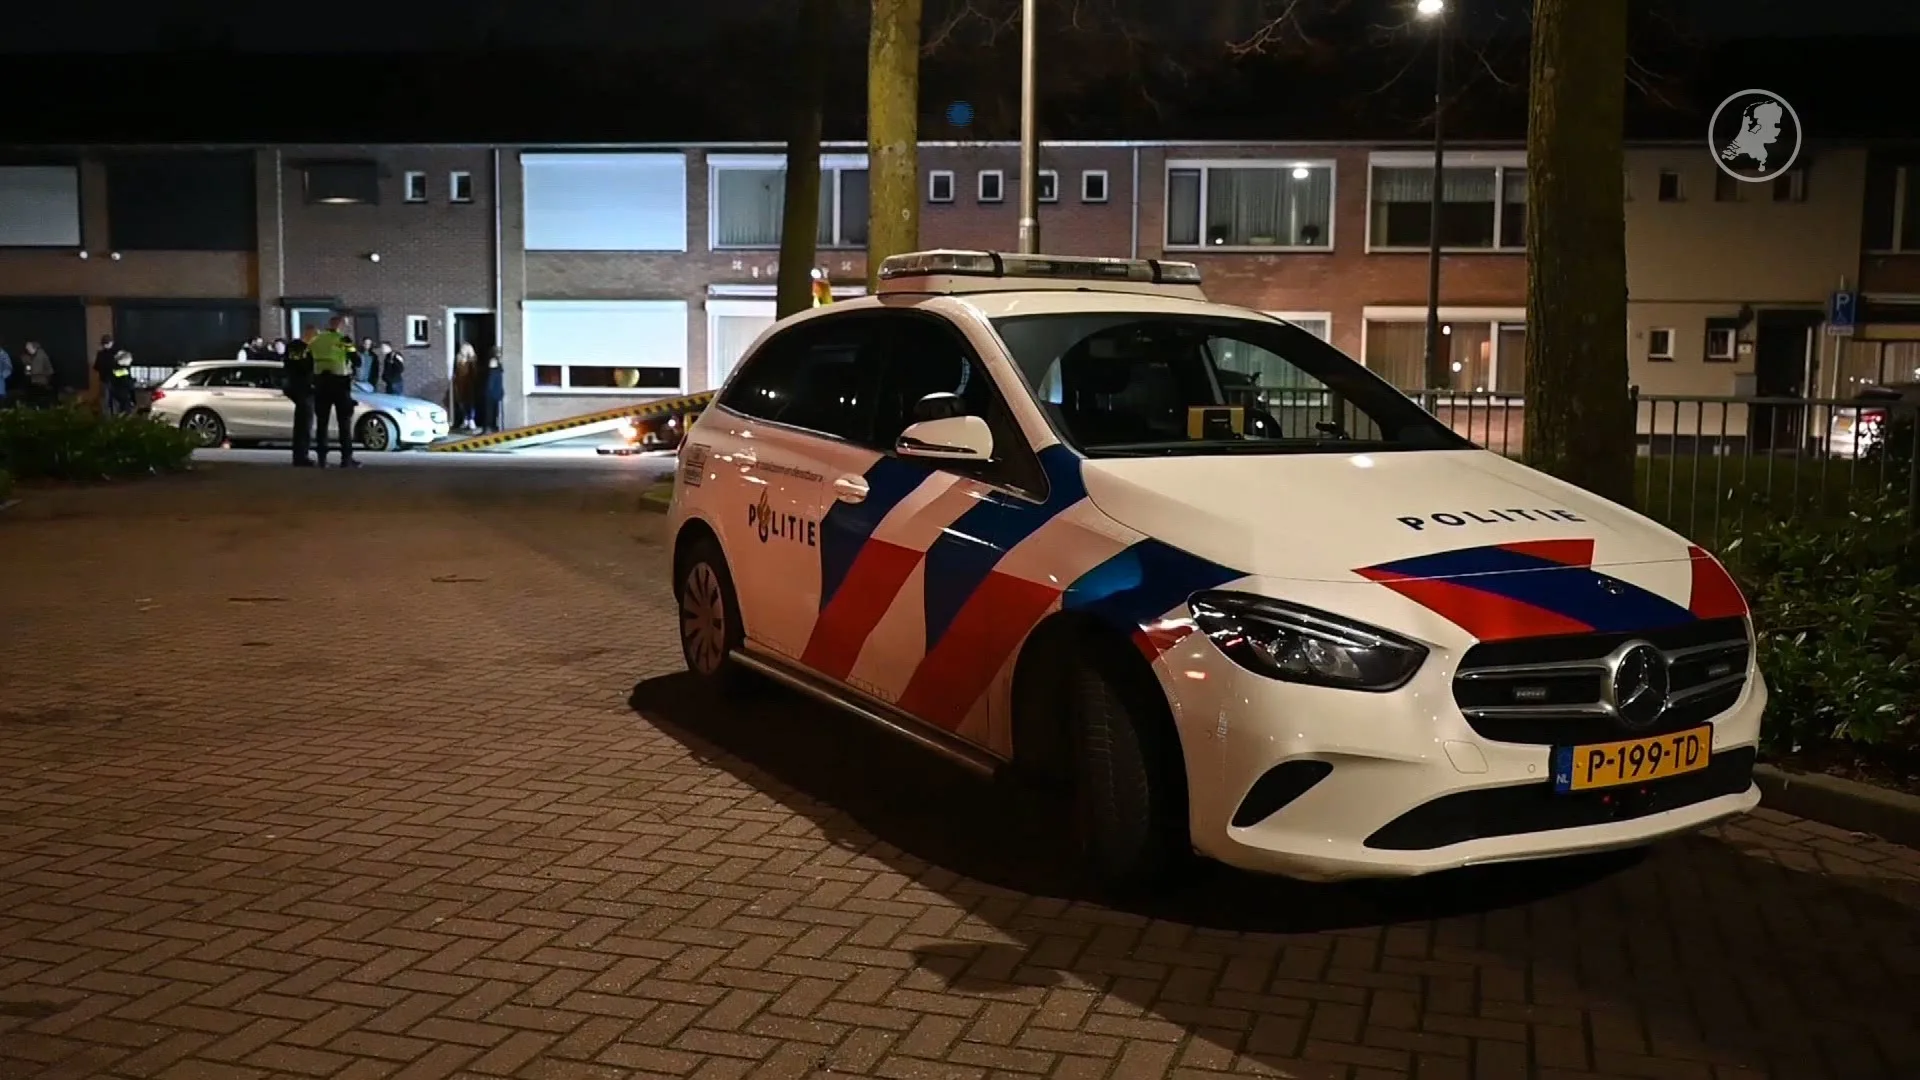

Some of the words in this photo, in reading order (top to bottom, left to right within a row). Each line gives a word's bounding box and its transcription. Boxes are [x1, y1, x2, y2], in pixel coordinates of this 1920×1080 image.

[748, 503, 816, 546] POLITIE
[1396, 509, 1586, 531] POLITIE
[1587, 734, 1699, 783] P-199-TD
[1556, 773, 1569, 784] NL
